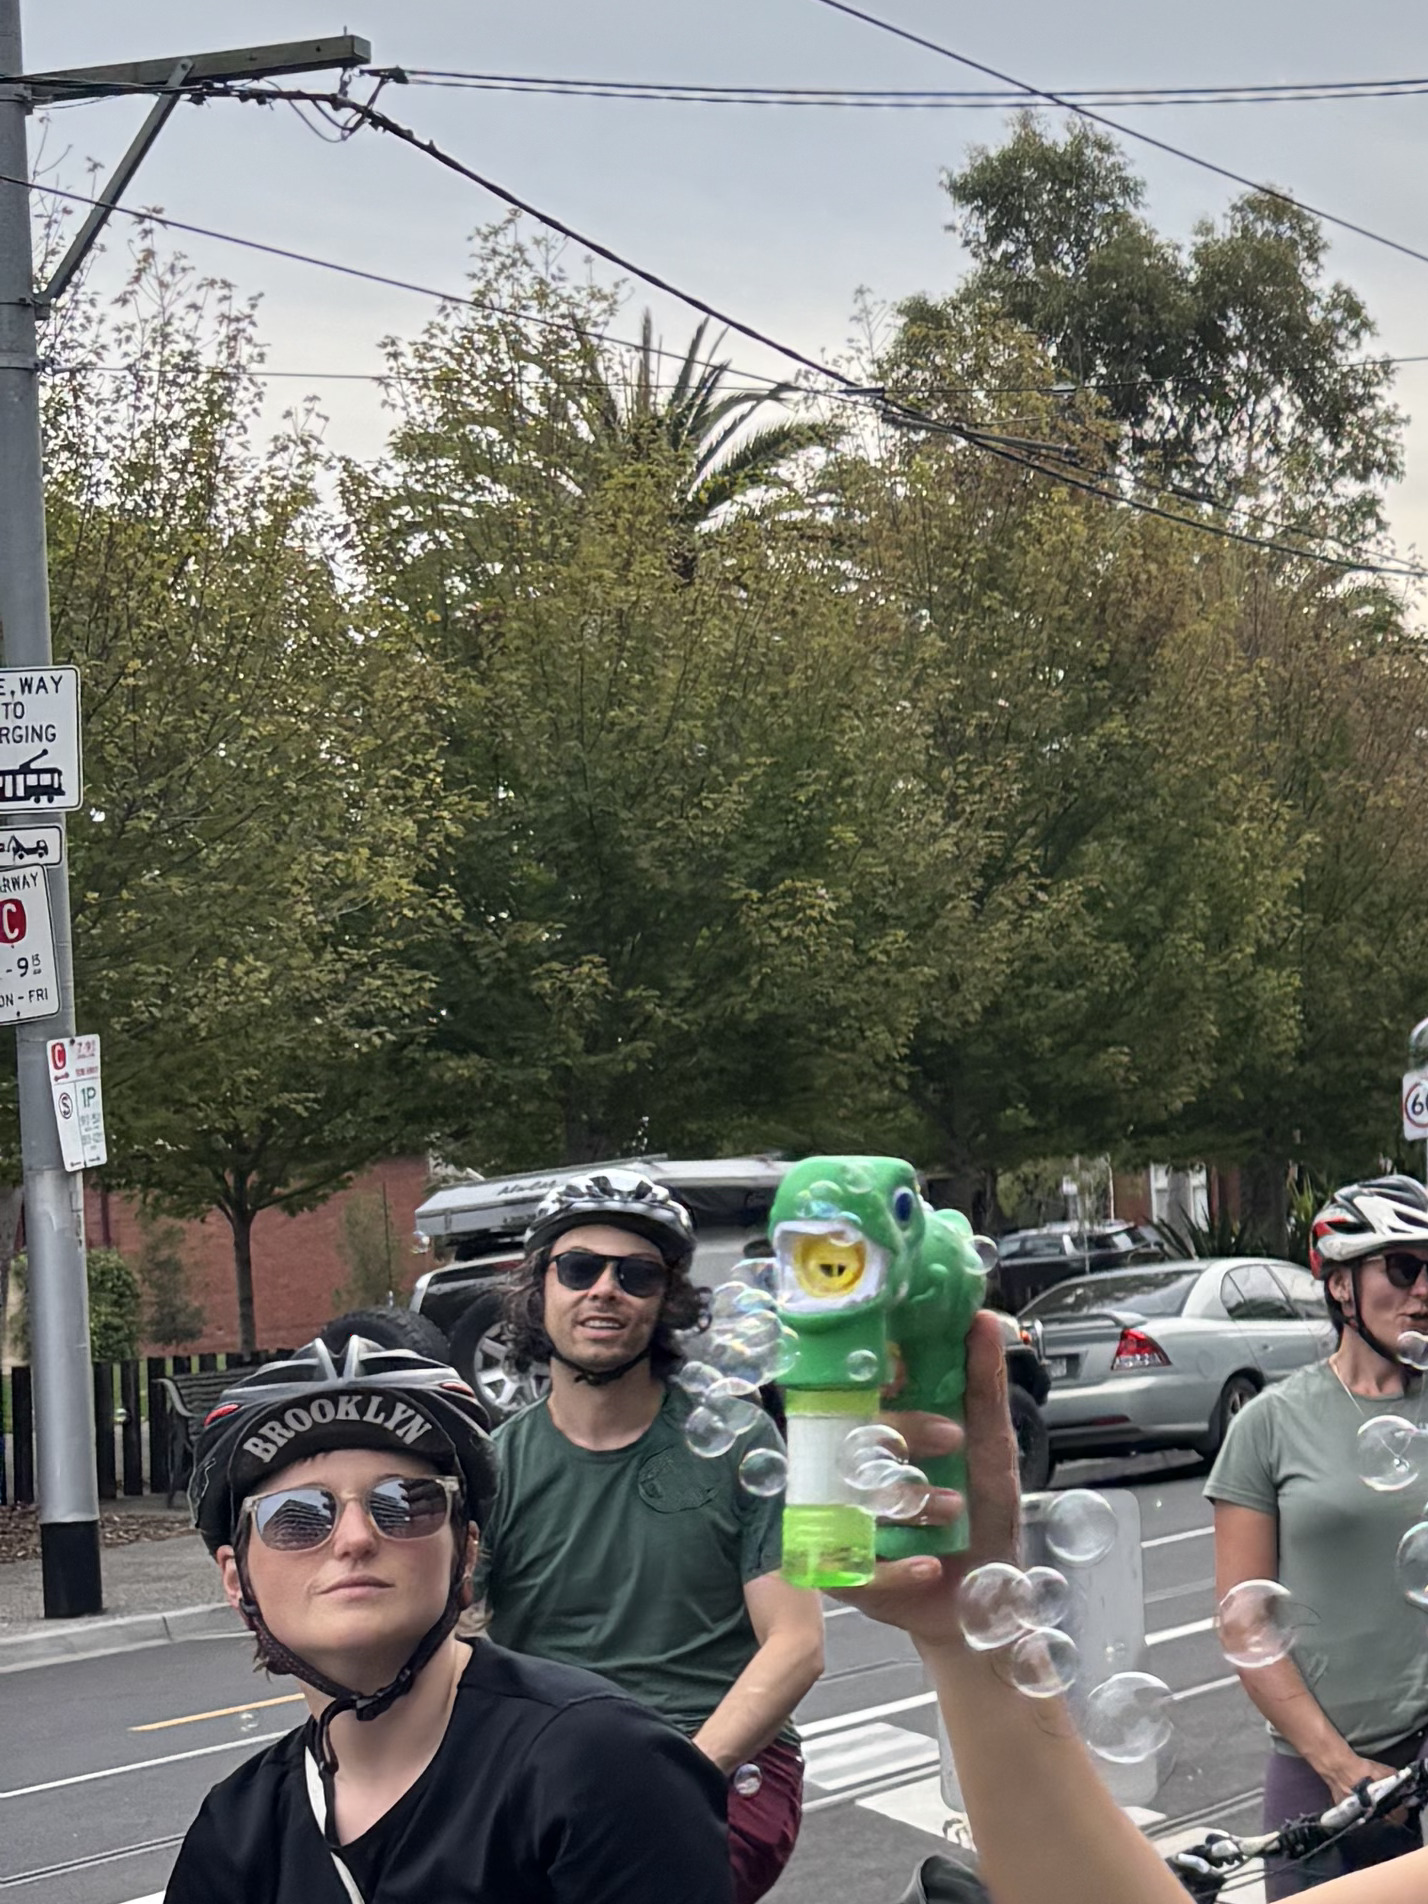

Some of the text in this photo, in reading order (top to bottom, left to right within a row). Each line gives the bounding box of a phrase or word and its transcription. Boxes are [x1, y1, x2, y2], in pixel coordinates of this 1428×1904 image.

[19, 675, 63, 696] WAY
[0, 701, 25, 720] TO
[28, 987, 48, 1003] FRI
[243, 1395, 432, 1463] BROOKLYN
